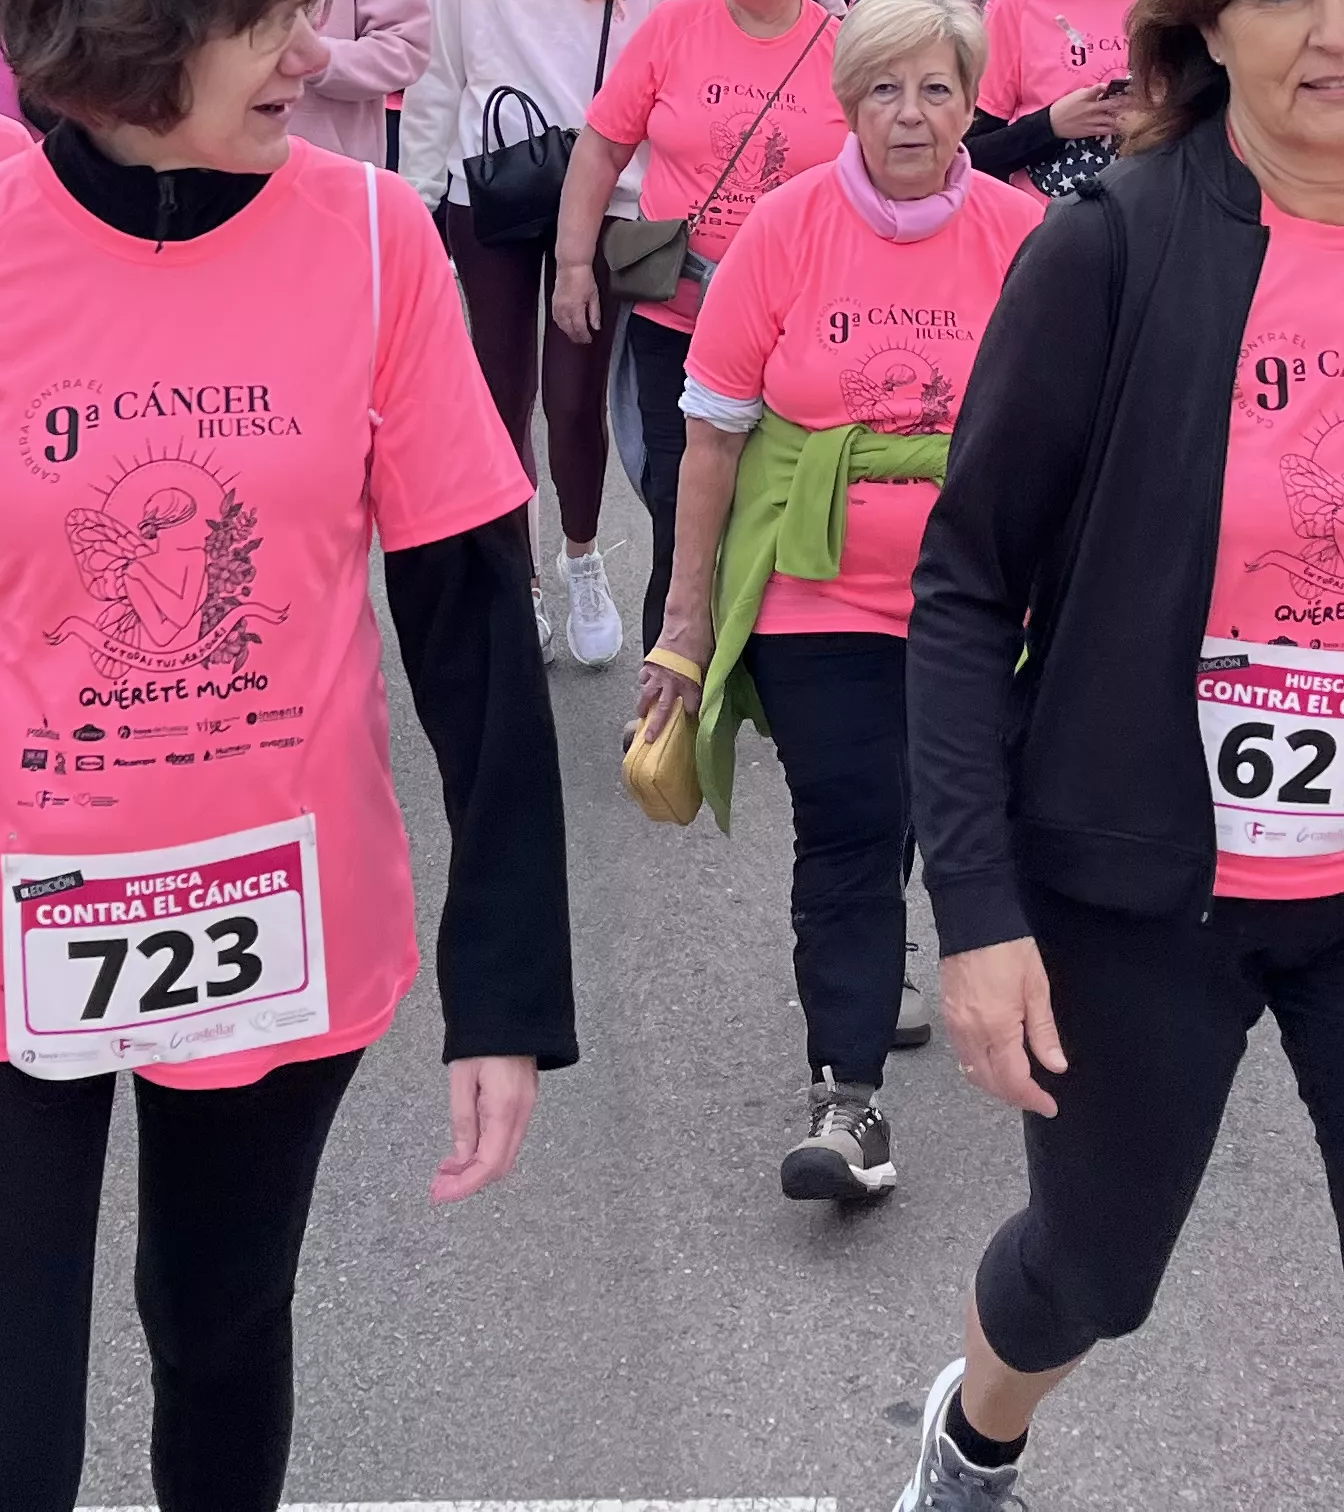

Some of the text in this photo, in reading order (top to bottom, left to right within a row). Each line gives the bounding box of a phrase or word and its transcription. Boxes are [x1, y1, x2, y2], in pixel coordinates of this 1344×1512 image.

[1099, 36, 1129, 51] CÁN
[707, 83, 729, 104] 9ª
[829, 304, 958, 344] 9ª CÁNCER
[916, 327, 976, 341] HUESCA
[25, 378, 82, 419] CONTRA
[87, 379, 104, 394] EL
[1256, 356, 1306, 411] 9ª
[44, 381, 271, 463] 9ª CÁNCER
[198, 416, 303, 438] HUESCA
[79, 671, 269, 710] QUIÉRETE MUCHO
[1197, 678, 1301, 712] CONTRA
[1307, 694, 1333, 715] EL
[36, 869, 289, 926] CONTRA EL CÁNCER
[126, 870, 203, 897] HUESCA
[68, 916, 263, 1021] 723
[184, 1023, 236, 1046] castellar
